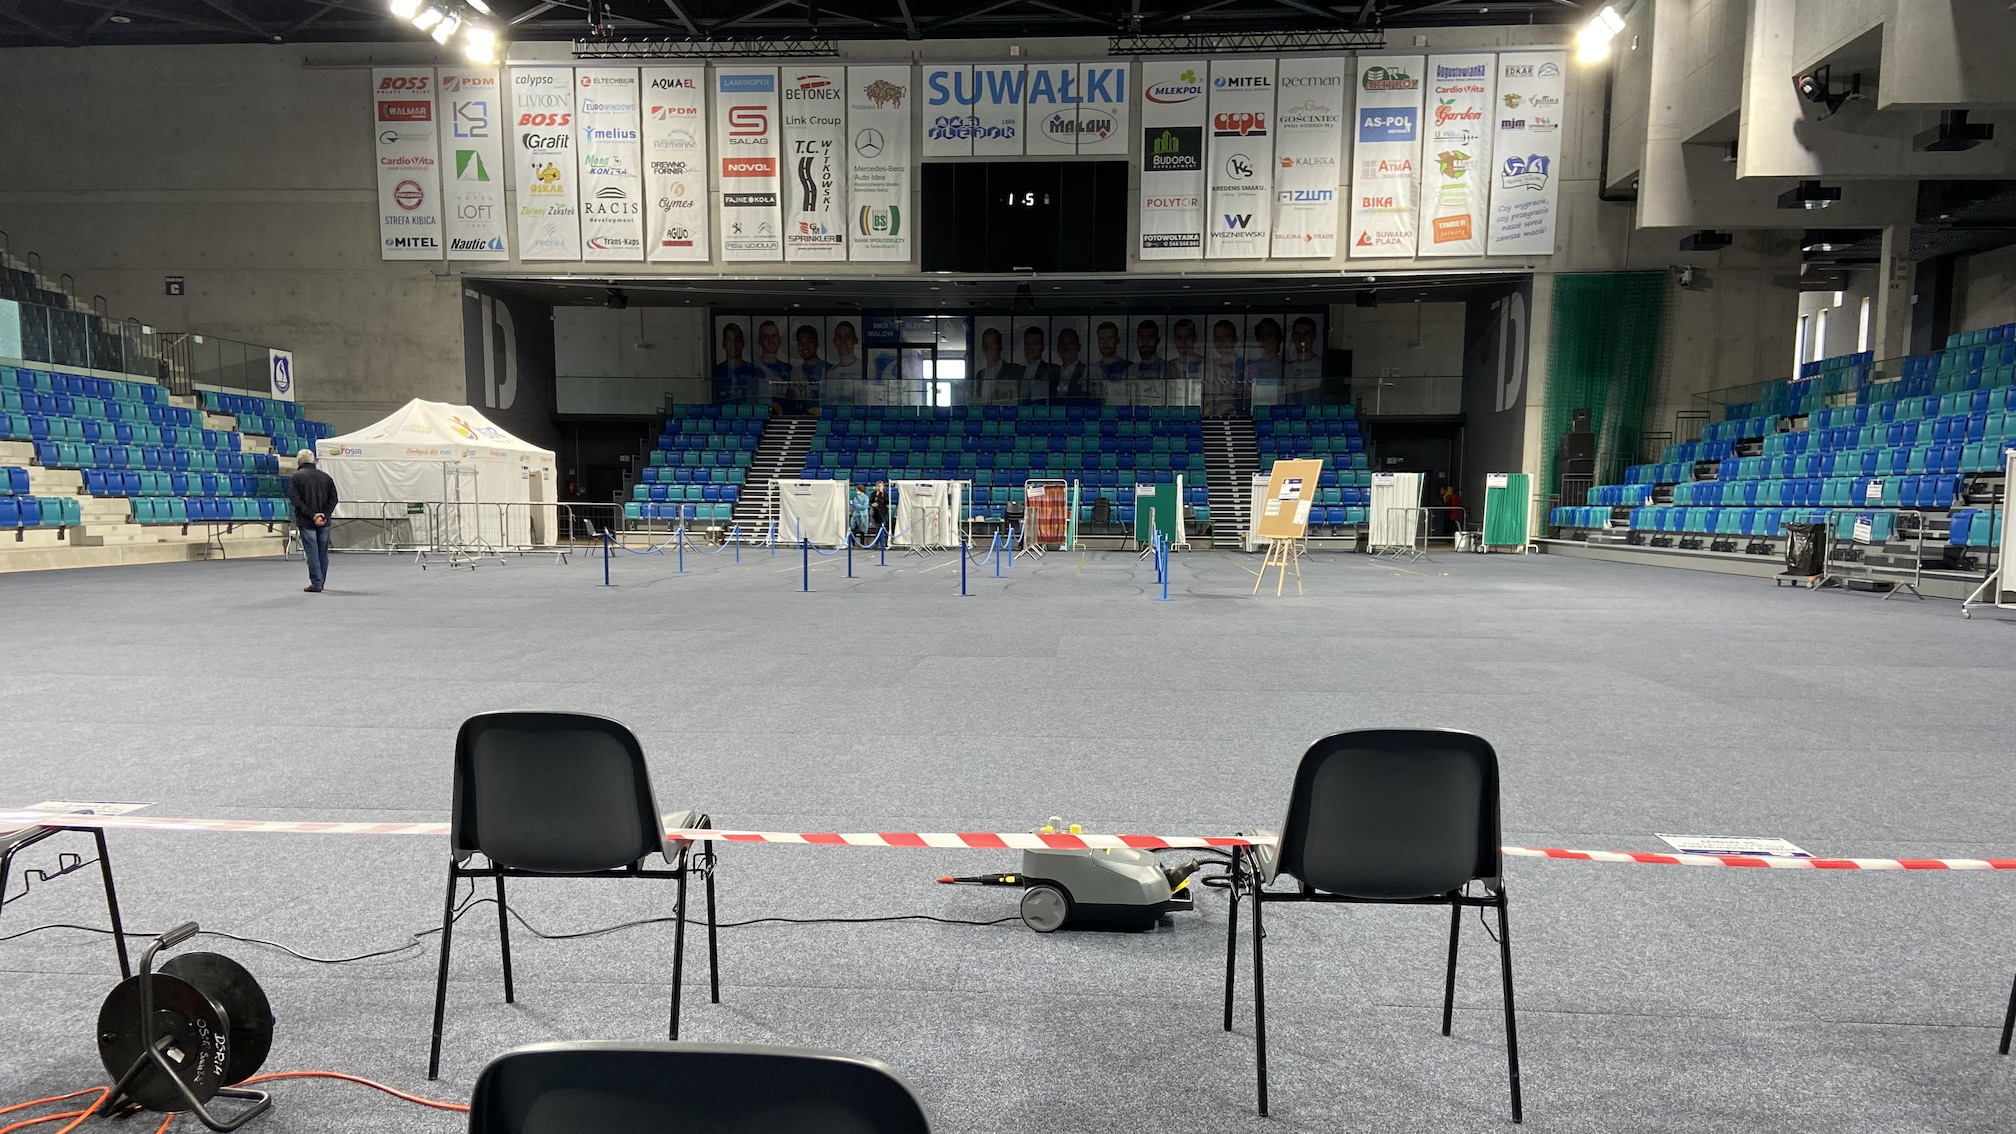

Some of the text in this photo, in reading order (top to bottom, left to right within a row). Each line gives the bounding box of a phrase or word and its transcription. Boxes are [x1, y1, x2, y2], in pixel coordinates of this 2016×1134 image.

[1436, 65, 1485, 78] Augustowianka
[380, 77, 429, 90] BOSS
[515, 74, 554, 87] calypso
[651, 78, 696, 89] AQUAEL
[1228, 77, 1271, 87] MITEL
[928, 69, 1124, 105] SUWAŁKI
[1155, 86, 1202, 95] MLEKPOL
[1436, 85, 1484, 94] Cardio Vita
[786, 89, 840, 100] BETONEX
[389, 107, 426, 116] WALMAR
[1435, 105, 1482, 126] Garden
[518, 113, 572, 126] BOSS
[786, 116, 841, 126] Link Group
[1280, 114, 1340, 122] GOŚCINIEC
[1364, 116, 1412, 127] AS-POL
[1501, 118, 1525, 128] mjm
[595, 128, 636, 138] melius
[528, 134, 570, 148] Grafit
[795, 141, 818, 154] T.C.
[412, 157, 434, 165] Vita
[1153, 155, 1196, 164] BUDOPOL
[530, 184, 564, 193] OSKAR
[1147, 198, 1198, 207] POLYTOR
[1362, 197, 1393, 208] BIKA
[458, 205, 492, 219] LOFT
[585, 203, 638, 214] RACIS
[385, 216, 436, 225] STREFA KIBICA
[874, 215, 886, 227] BS
[1439, 220, 1466, 229] TIMBER
[1524, 219, 1542, 227] serca
[395, 238, 438, 247] MITEL
[1496, 233, 1521, 242] zawsze
[451, 238, 486, 250] Nautic
[171, 284, 180, 294] C
